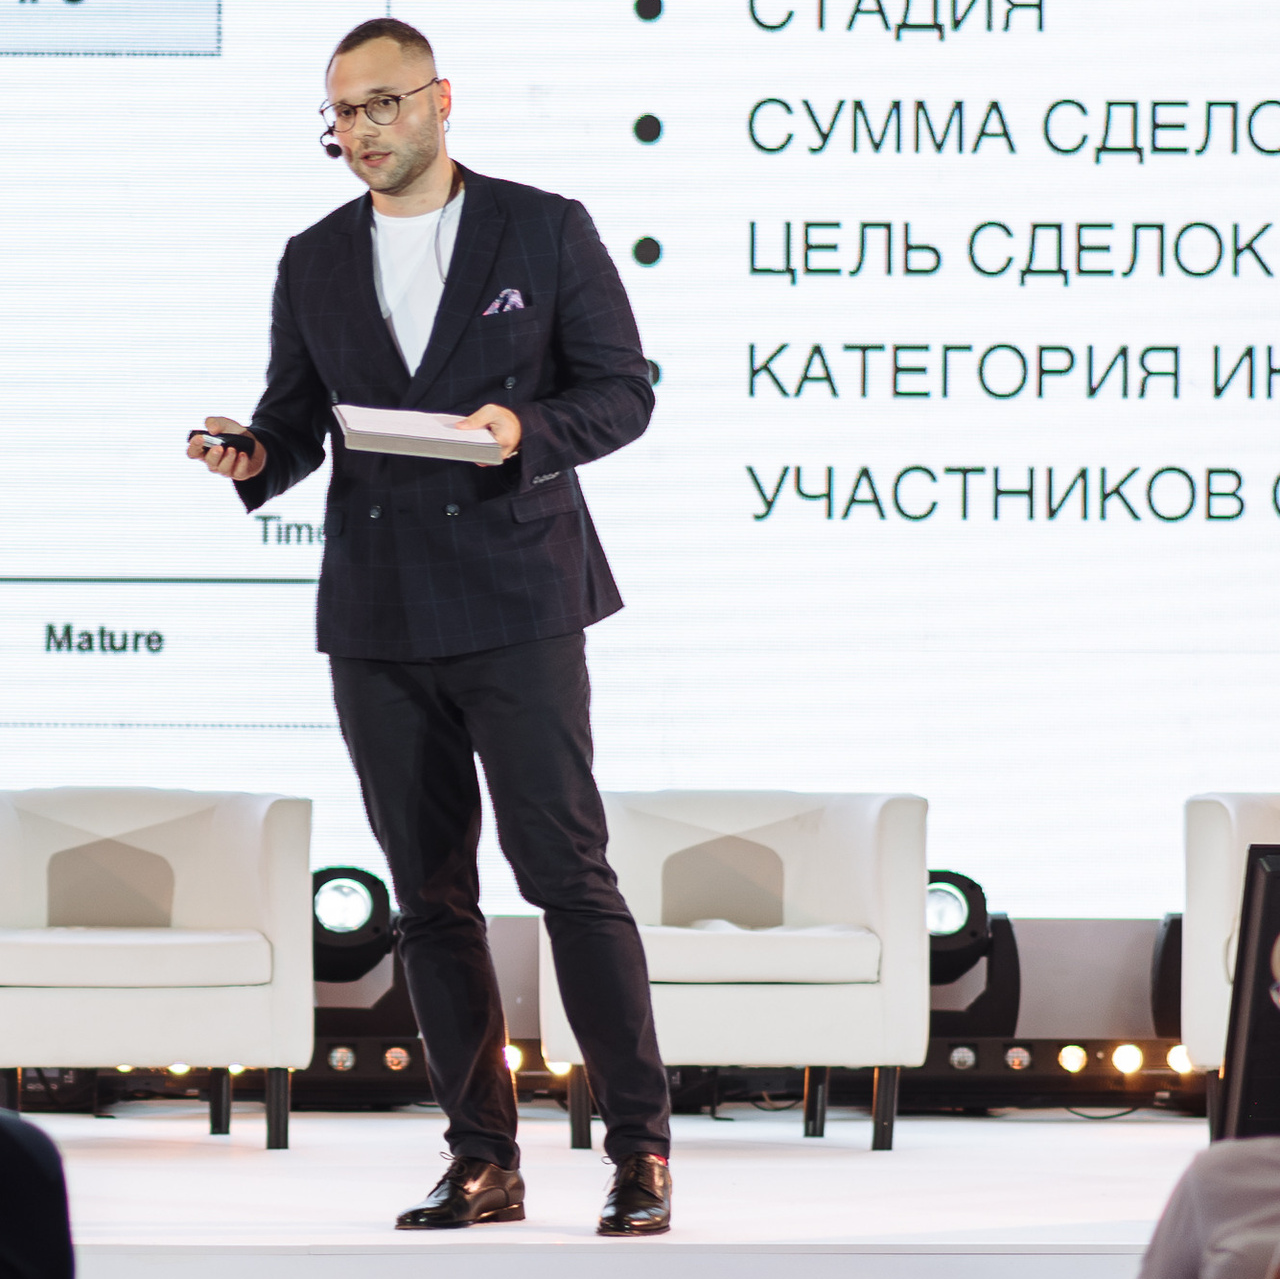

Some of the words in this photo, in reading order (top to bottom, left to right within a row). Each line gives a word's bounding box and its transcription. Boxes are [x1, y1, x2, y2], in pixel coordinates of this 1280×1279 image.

[747, 97, 1017, 155] СУММА
[1042, 98, 1280, 165] СДЕЛО
[749, 221, 943, 286] ЦЕЛЬ
[967, 220, 1274, 287] СДЕЛОК
[748, 342, 1181, 401] КАТЕГОРИЯ
[745, 464, 1246, 524] УЧАСТНИКОВ
[44, 623, 165, 654] Mature
